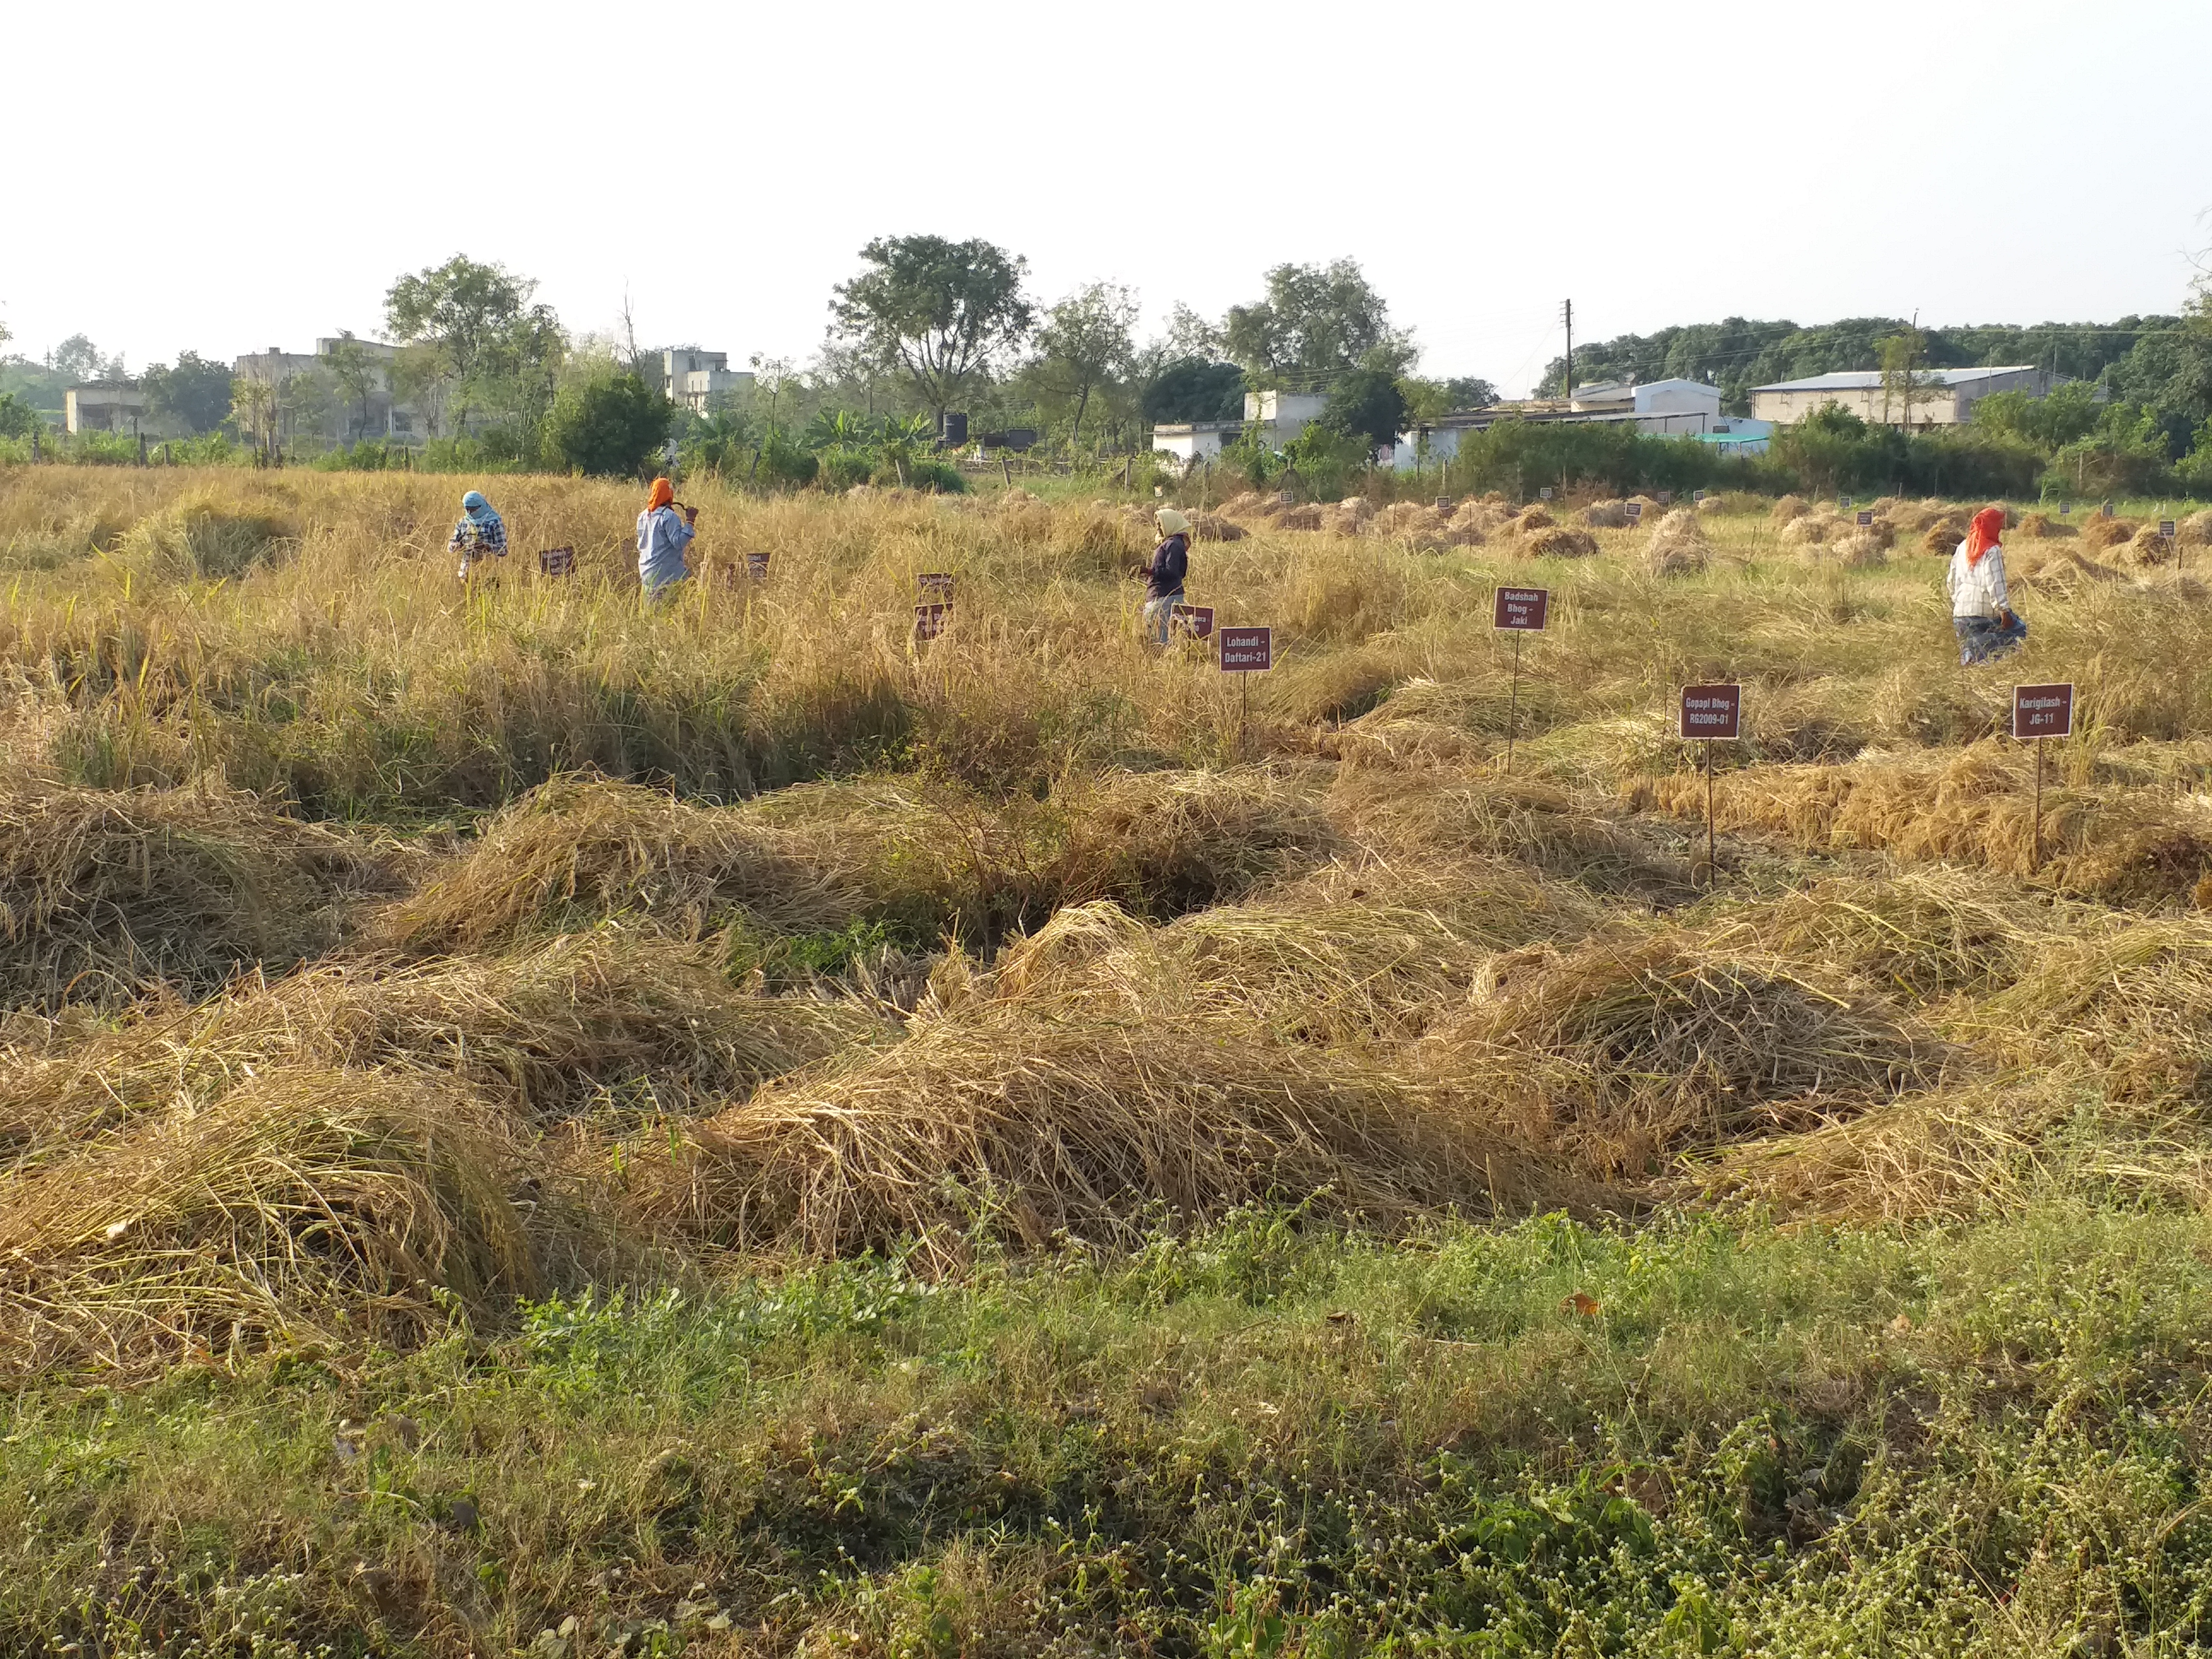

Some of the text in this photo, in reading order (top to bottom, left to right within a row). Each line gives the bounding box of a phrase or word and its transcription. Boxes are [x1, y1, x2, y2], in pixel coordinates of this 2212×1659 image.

[1504, 591, 1539, 601] Badshah
[1507, 603, 1527, 615] Bhog
[1510, 615, 1528, 625] Jaki
[1226, 636, 1259, 647] Lohandi
[1225, 651, 1266, 663] Daftari-21
[1712, 697, 1730, 710] Bhog
[2019, 696, 2060, 710] Karigilash
[2029, 713, 2054, 725] JG-11
